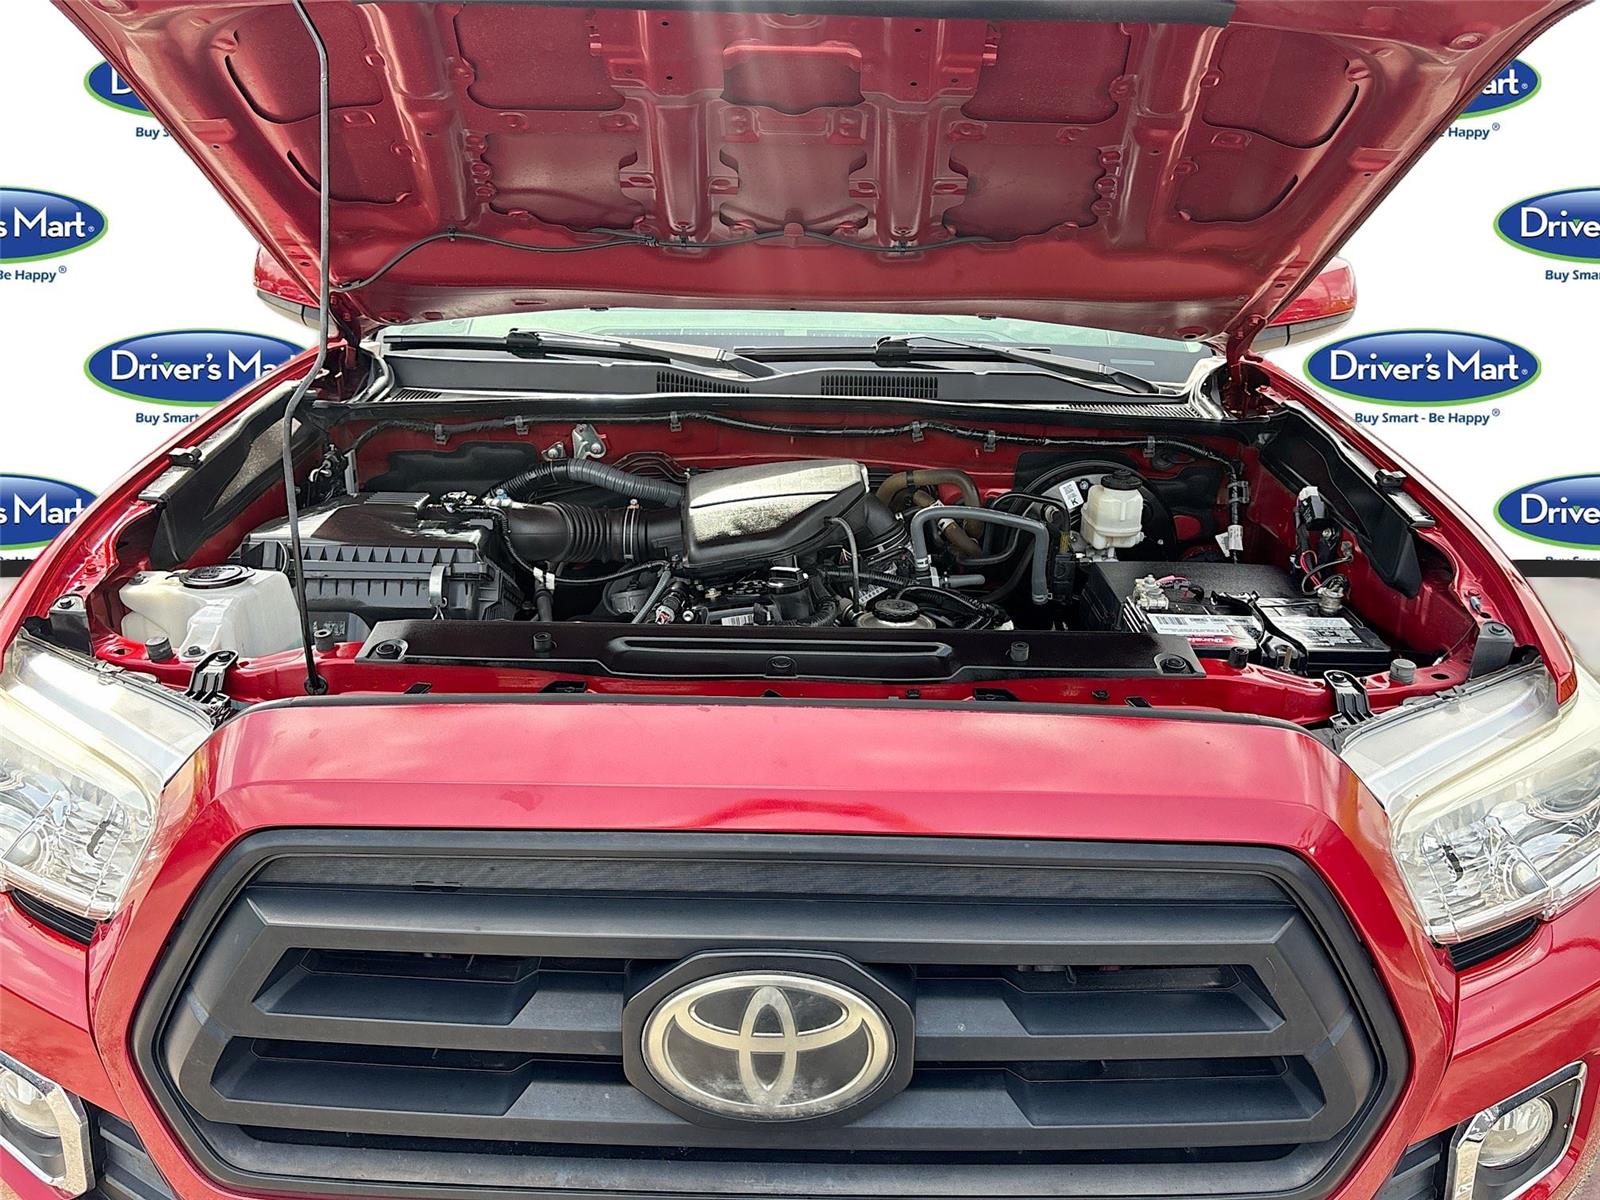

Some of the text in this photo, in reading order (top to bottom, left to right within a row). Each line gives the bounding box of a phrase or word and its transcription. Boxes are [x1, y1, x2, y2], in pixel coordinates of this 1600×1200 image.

[1481, 69, 1519, 95] art
[136, 127, 160, 140] Buy
[1448, 128, 1490, 140] Happy
[14, 206, 86, 238] Mart
[1521, 206, 1600, 238] Drive
[15, 269, 57, 283] Happy
[1545, 269, 1600, 283] Buy Sma
[111, 349, 296, 381] Driver's Ma
[1330, 349, 1519, 381] Driver's Mart
[136, 412, 160, 426] Buy
[1355, 412, 1379, 426] Buy
[1382, 412, 1419, 424] Smart
[1429, 412, 1445, 424] Be
[1448, 412, 1490, 426] Happy
[1521, 492, 1600, 526] Drive
